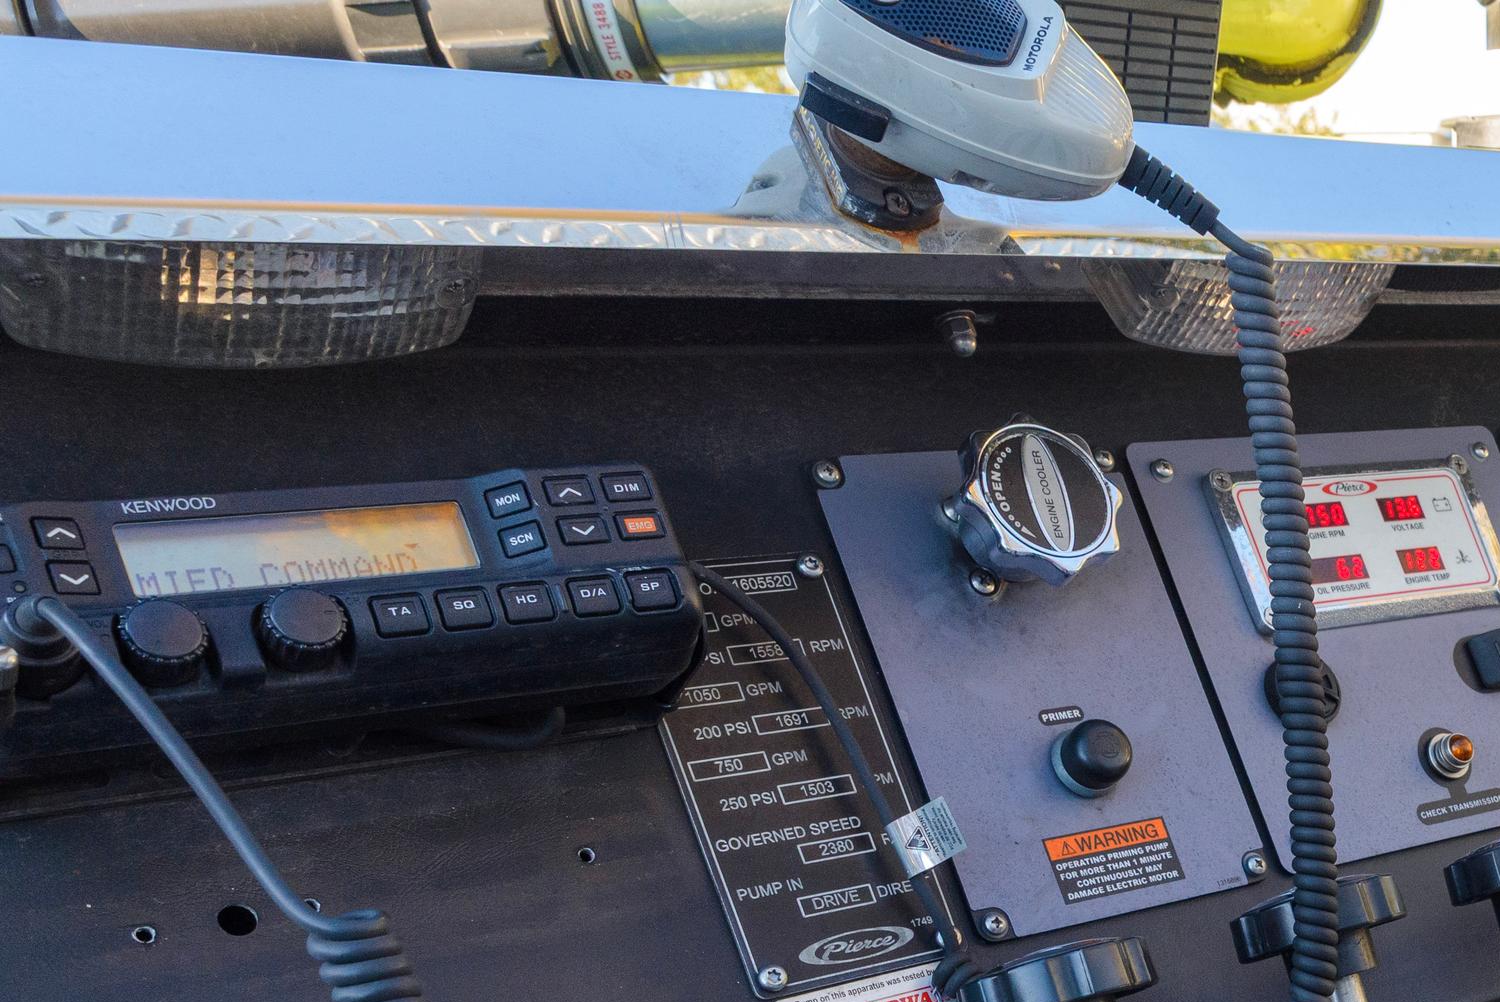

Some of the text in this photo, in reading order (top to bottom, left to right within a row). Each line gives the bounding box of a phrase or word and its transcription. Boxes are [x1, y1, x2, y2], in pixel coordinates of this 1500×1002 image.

[1022, 16, 1054, 72] MOTOROLA
[613, 483, 640, 494] DIM
[991, 470, 1011, 512] OPEN
[1033, 450, 1064, 540] ENGINE COOLER
[1334, 480, 1366, 494] Pierce
[120, 497, 217, 515] KENWOOD
[495, 493, 521, 508] MON
[627, 520, 653, 531] EMG
[1328, 529, 1346, 539] RPM
[1391, 522, 1425, 532] VOLTAGE
[509, 532, 534, 547] SCN
[259, 551, 419, 588] COMMAND
[1405, 572, 1451, 585] ENGINE TEMP
[640, 582, 660, 592] SP
[732, 574, 792, 591] 1605520
[1317, 582, 1372, 595] OIL PRESSURE
[515, 594, 538, 605] HC
[580, 587, 607, 598] D/A
[388, 605, 412, 617] TA
[453, 599, 475, 611] SQ
[720, 613, 758, 628] GPM
[749, 638, 845, 659] 1558 RPM
[685, 681, 783, 703] 1050 GPM
[693, 704, 870, 741] 200 PSI 1691 RPM
[1041, 708, 1082, 723] PRIMER
[714, 749, 809, 774] 750 GPM
[719, 780, 836, 812] 250 PSI 1503
[1420, 806, 1447, 820] CHECK
[715, 816, 863, 853] GOVERNED SPEED
[1074, 823, 1160, 852] WARNING
[818, 838, 856, 857] 2380
[1056, 841, 1169, 871] OPERATING PRIMING PUMP
[1060, 851, 1173, 881] FOR MORE THAN 1 MINUTE
[1076, 863, 1163, 888] CONTINUOUSLY MAY
[736, 877, 805, 902] PUMP IN
[1067, 869, 1180, 901] DAMAGE ELECTRIC MOTOR
[811, 890, 862, 911] DRIVE
[910, 915, 934, 928] 1749
[822, 933, 897, 957] Pierce
[820, 993, 830, 1002] on
[830, 988, 847, 1000] this
[847, 980, 886, 997] apparatus
[886, 977, 902, 987] was
[902, 970, 927, 983] tested
